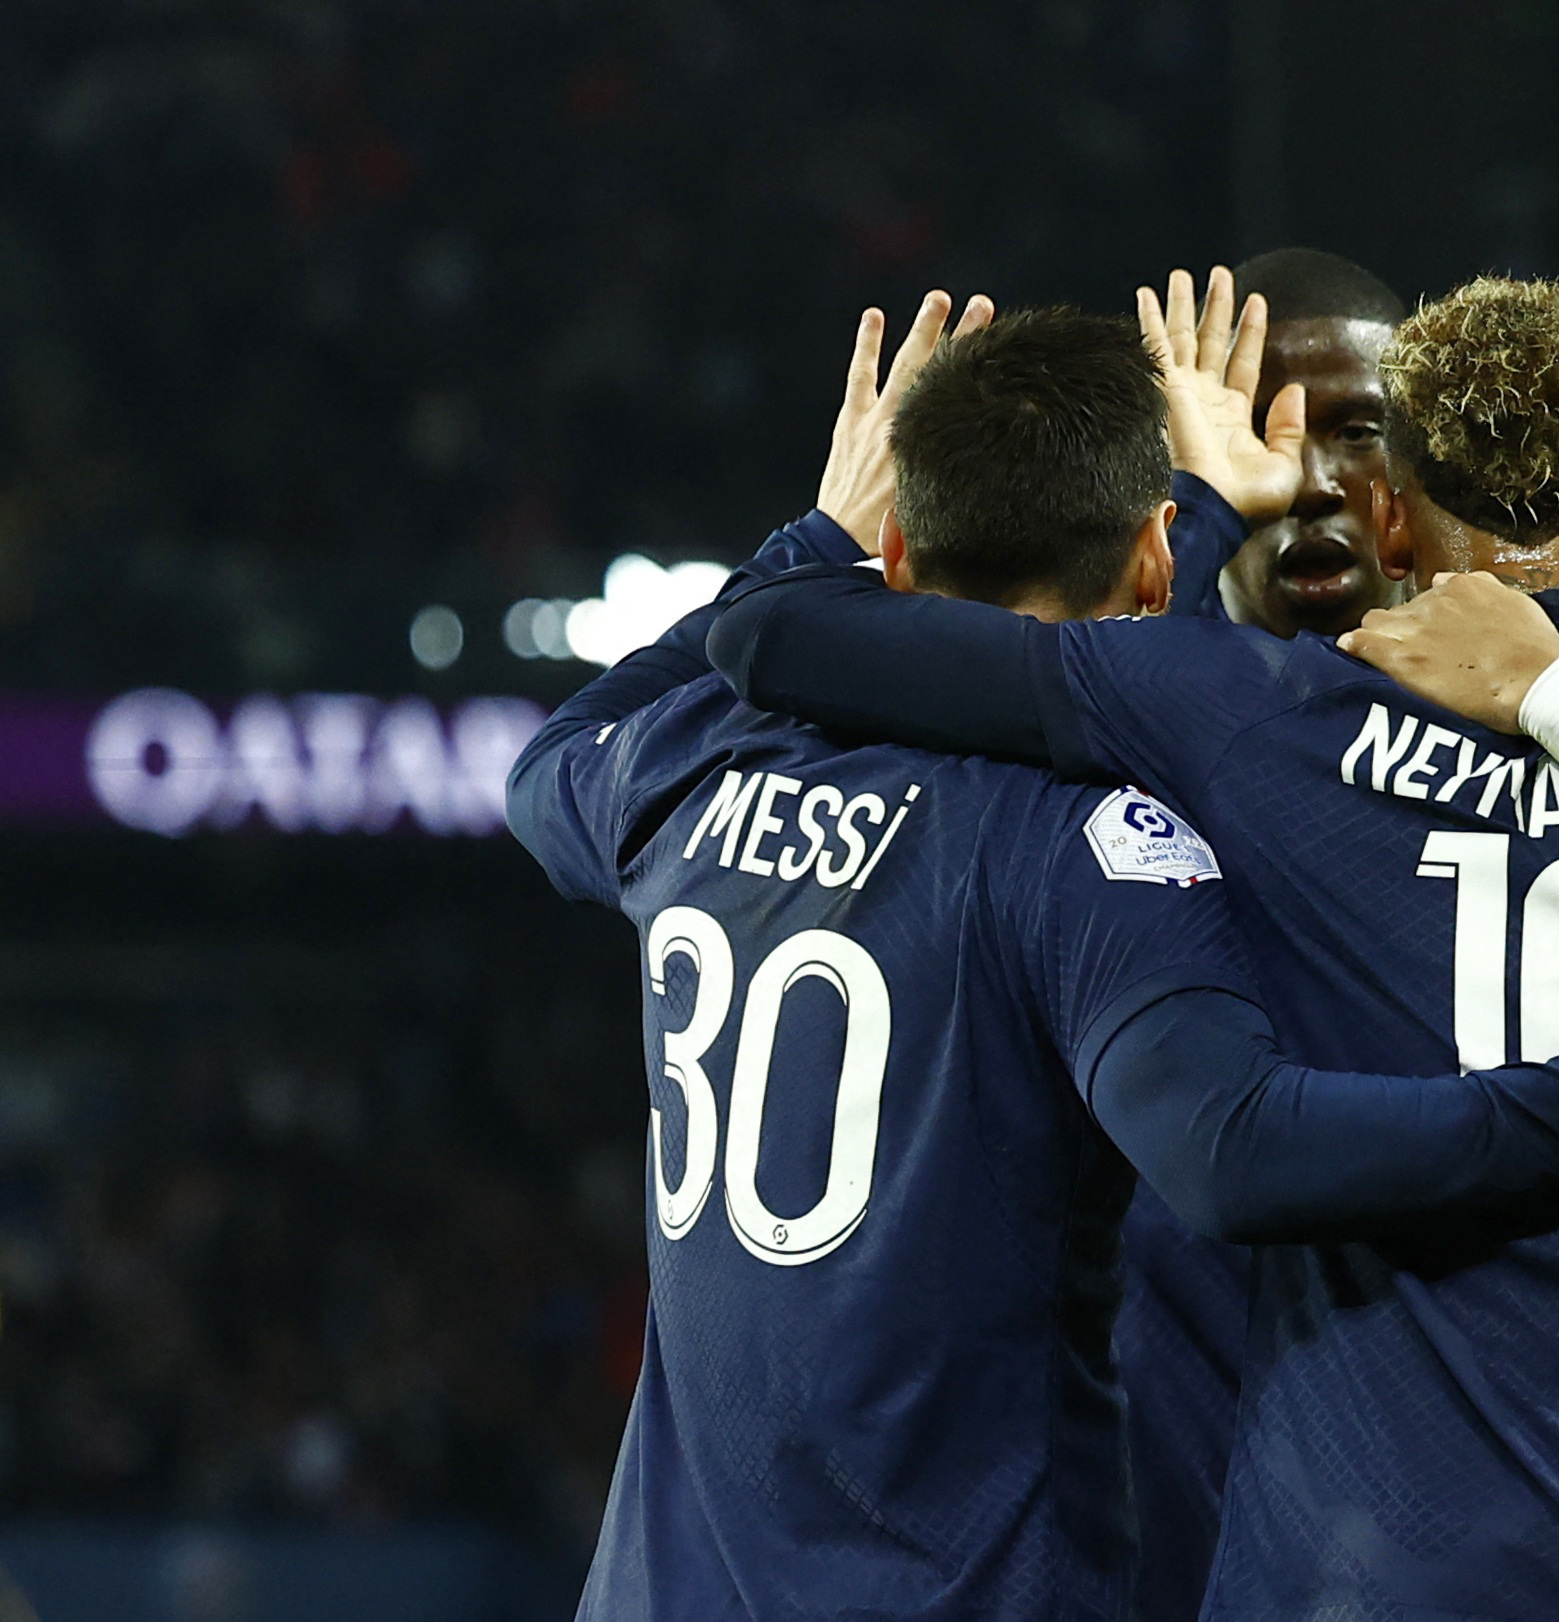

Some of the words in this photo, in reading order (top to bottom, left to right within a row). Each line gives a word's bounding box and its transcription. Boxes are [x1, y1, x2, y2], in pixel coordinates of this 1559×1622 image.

[88, 688, 552, 838] QATAR
[1135, 853, 1169, 866] Uber
[1138, 841, 1180, 853] LIGUE
[648, 906, 891, 1266] 30
